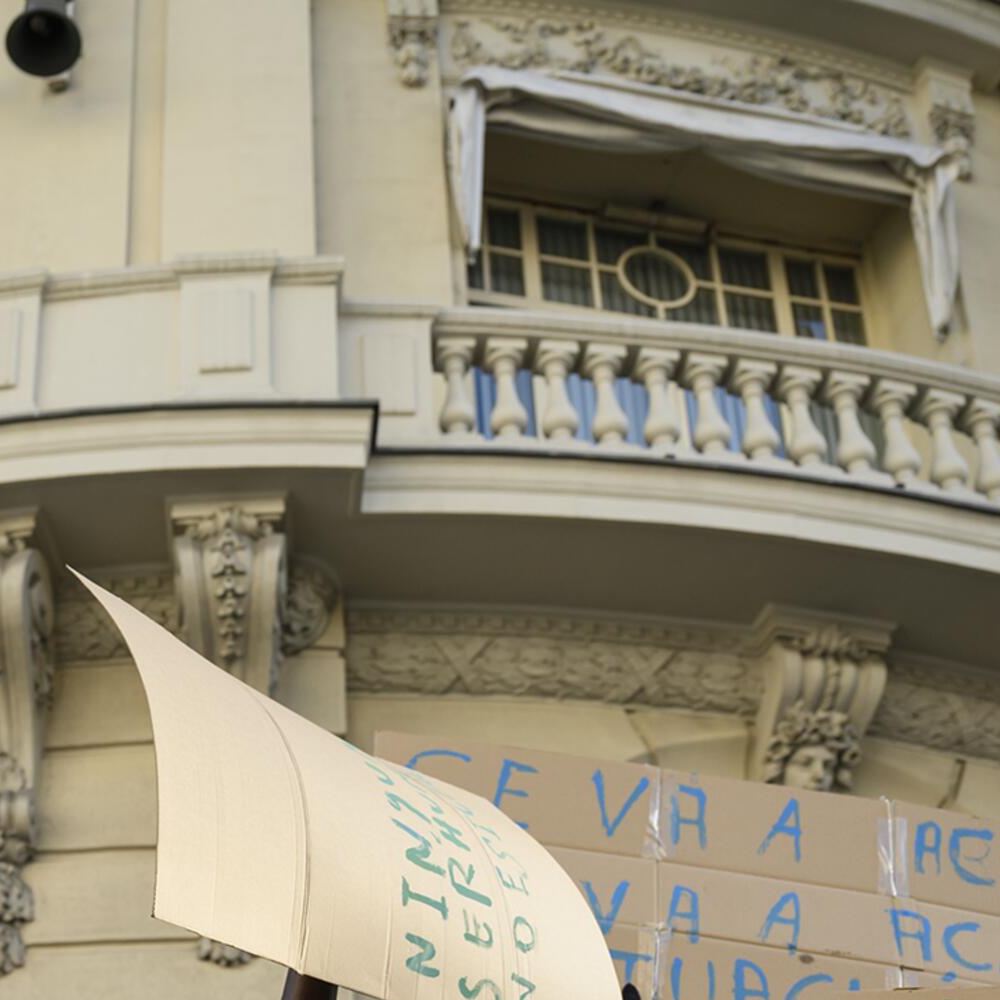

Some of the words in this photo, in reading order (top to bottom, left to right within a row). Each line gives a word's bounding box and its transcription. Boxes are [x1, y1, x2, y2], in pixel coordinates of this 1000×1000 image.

[591, 768, 707, 850] VA
[755, 797, 802, 864] A
[580, 878, 700, 945] VA
[756, 891, 802, 956] A
